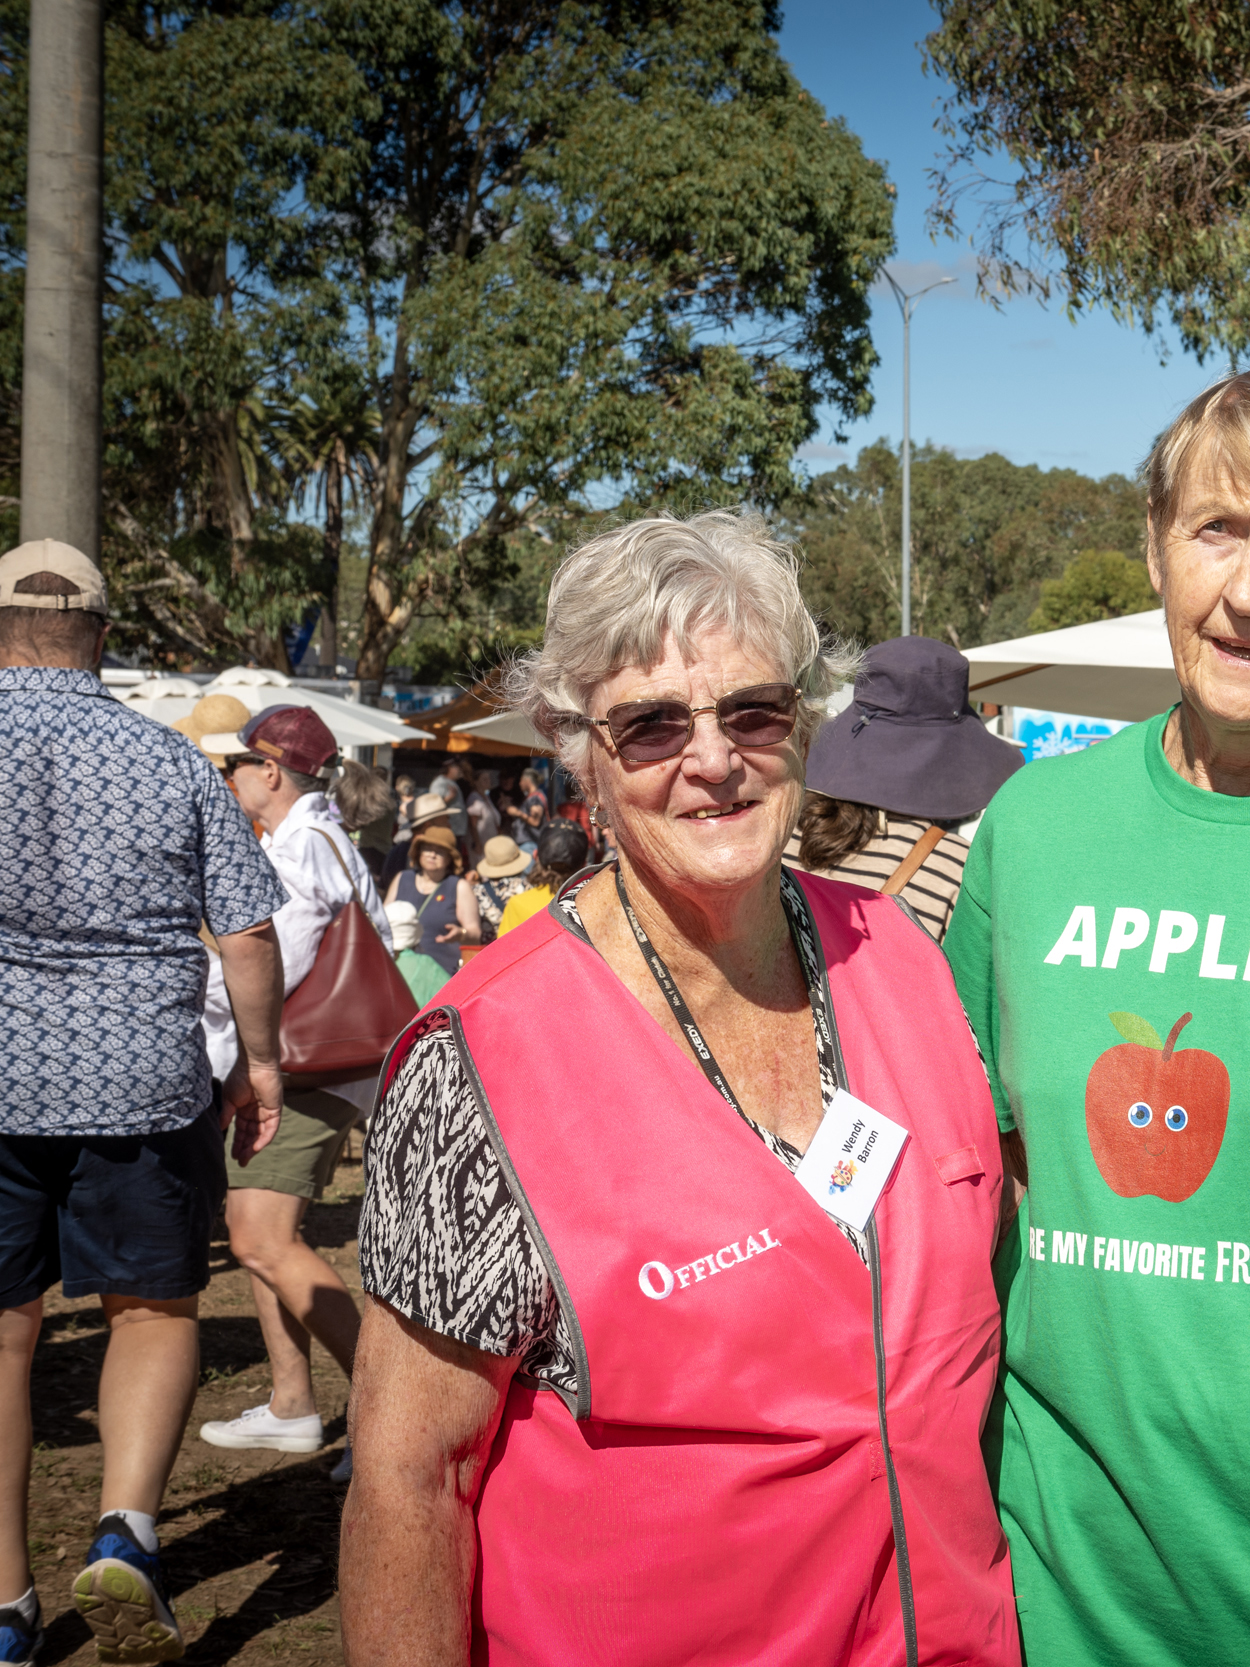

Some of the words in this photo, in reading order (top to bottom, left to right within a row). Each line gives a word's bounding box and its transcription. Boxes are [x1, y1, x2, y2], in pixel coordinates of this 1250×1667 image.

[684, 1023, 710, 1060] EXEDY
[815, 1008, 832, 1046] EXEDY
[842, 1119, 866, 1153] Wendy
[857, 1130, 879, 1163] Barron
[638, 1228, 782, 1300] OFFICIAL
[1052, 1230, 1087, 1266] MY
[1094, 1236, 1206, 1280] FAVORITE
